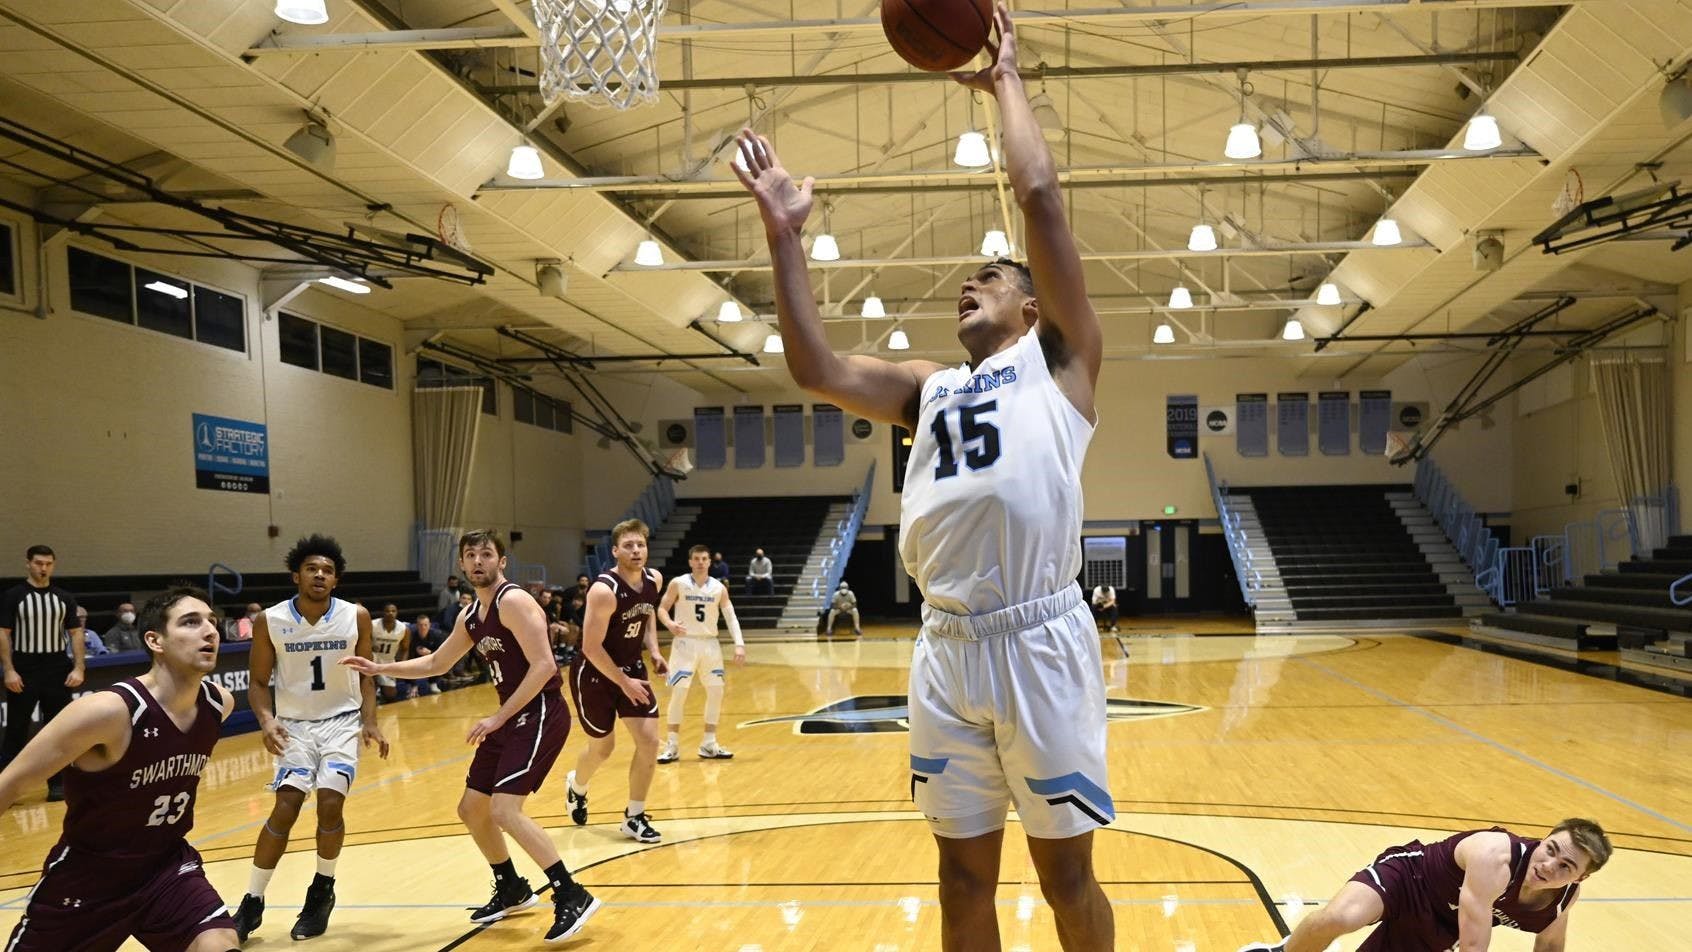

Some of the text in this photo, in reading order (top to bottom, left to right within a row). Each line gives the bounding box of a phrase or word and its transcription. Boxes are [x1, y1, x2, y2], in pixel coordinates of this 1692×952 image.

[1168, 407, 1197, 421] 2019
[215, 427, 265, 444] STRATEGIC
[930, 399, 1001, 481] 15
[216, 439, 265, 456] FACTORY
[695, 604, 706, 622] 5
[624, 621, 642, 638] 50
[284, 640, 347, 653] HOPKINS
[378, 643, 392, 655] 11
[310, 655, 326, 691] 1
[129, 753, 211, 789] SWARTHMO
[145, 791, 191, 827] 23
